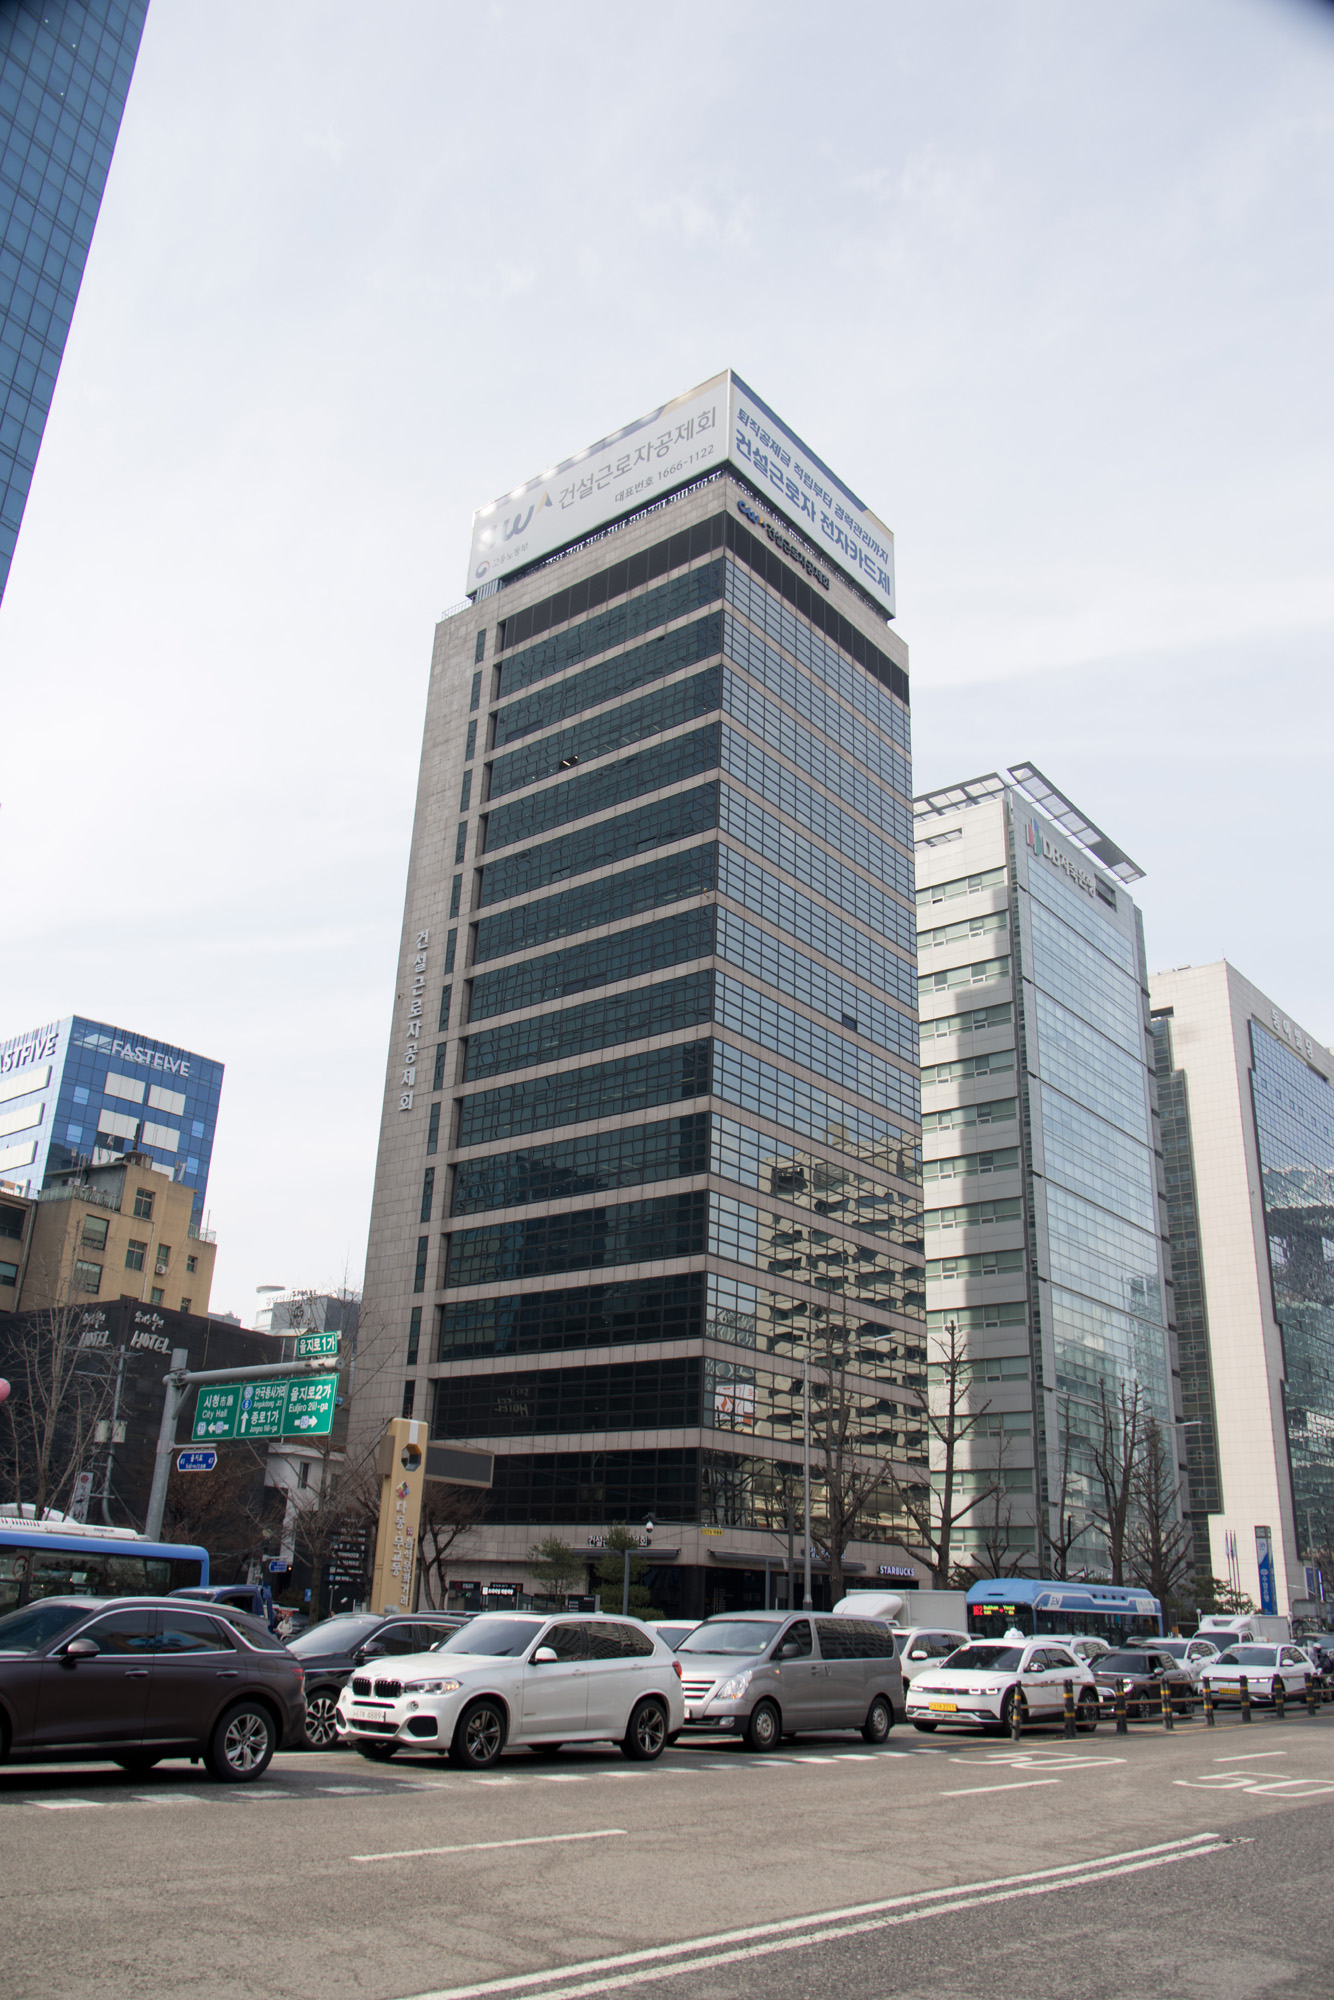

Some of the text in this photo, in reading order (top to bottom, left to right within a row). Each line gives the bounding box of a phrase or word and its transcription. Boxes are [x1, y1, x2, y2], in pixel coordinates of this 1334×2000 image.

[558, 406, 716, 509] 건설근로자공제회
[614, 444, 715, 503] 대표번호 1666-1122
[737, 408, 889, 564] 퇴직공제금 적립부터 경력관리까지
[736, 428, 891, 596] 건설근로자 전자카드제
[398, 928, 430, 1111] 건설근로자공제회
[111, 1040, 191, 1077] FASTFIVE
[130, 1330, 172, 1354] HOTEL
[299, 1335, 336, 1355] 을지로1가
[255, 1385, 287, 1400] 안국동사거리
[290, 1384, 331, 1402] 을지로2가
[202, 1409, 228, 1420] City Hall
[251, 1410, 279, 1425] 종로1가
[288, 1403, 307, 1414] Euljiro
[880, 1565, 915, 1577] STARBUCKS
[973, 1605, 983, 1616] 162
[949, 1751, 1127, 1770] 50
[1172, 1771, 1334, 1797] 50
